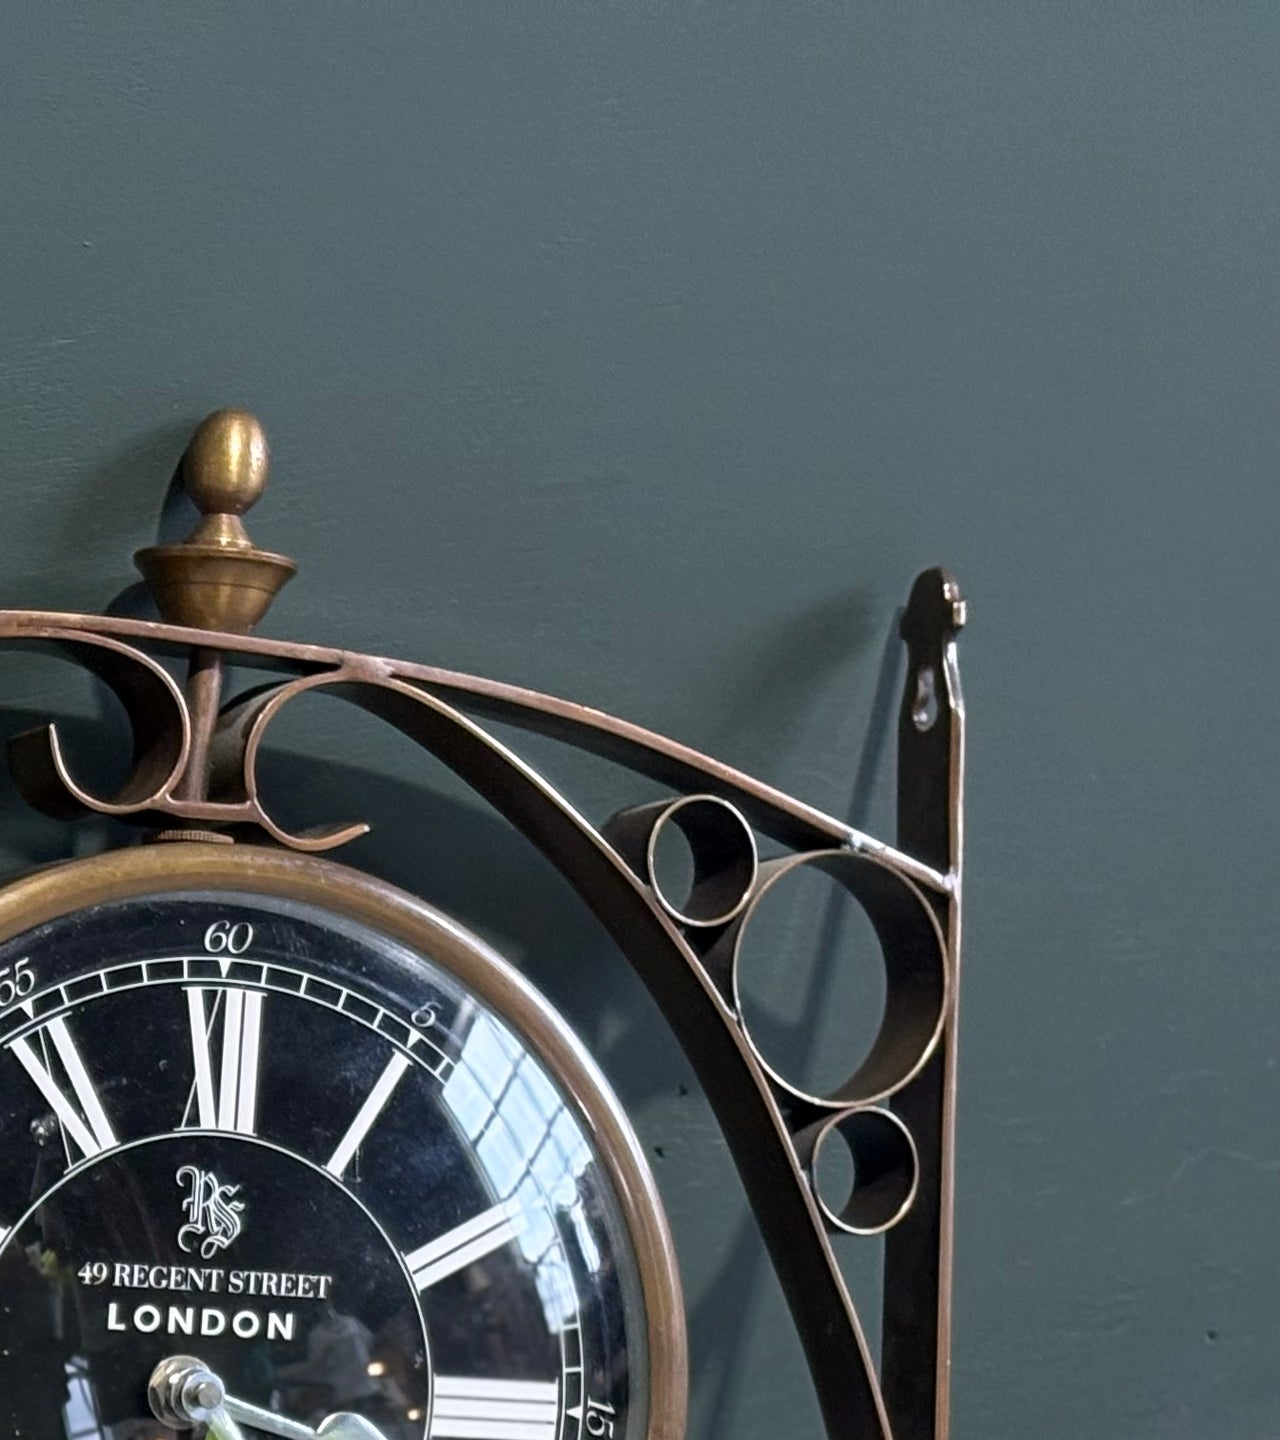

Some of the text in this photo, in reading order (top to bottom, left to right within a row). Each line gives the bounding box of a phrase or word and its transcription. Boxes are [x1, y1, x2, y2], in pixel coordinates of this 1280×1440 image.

[203, 920, 255, 955] 60
[173, 985, 269, 1138] XII
[2, 1010, 122, 1176] XI
[321, 1047, 415, 1183] I
[76, 1261, 333, 1300] 49 REGENT STREET
[106, 1301, 295, 1342] LONDON
[585, 1394, 617, 1440] 15
